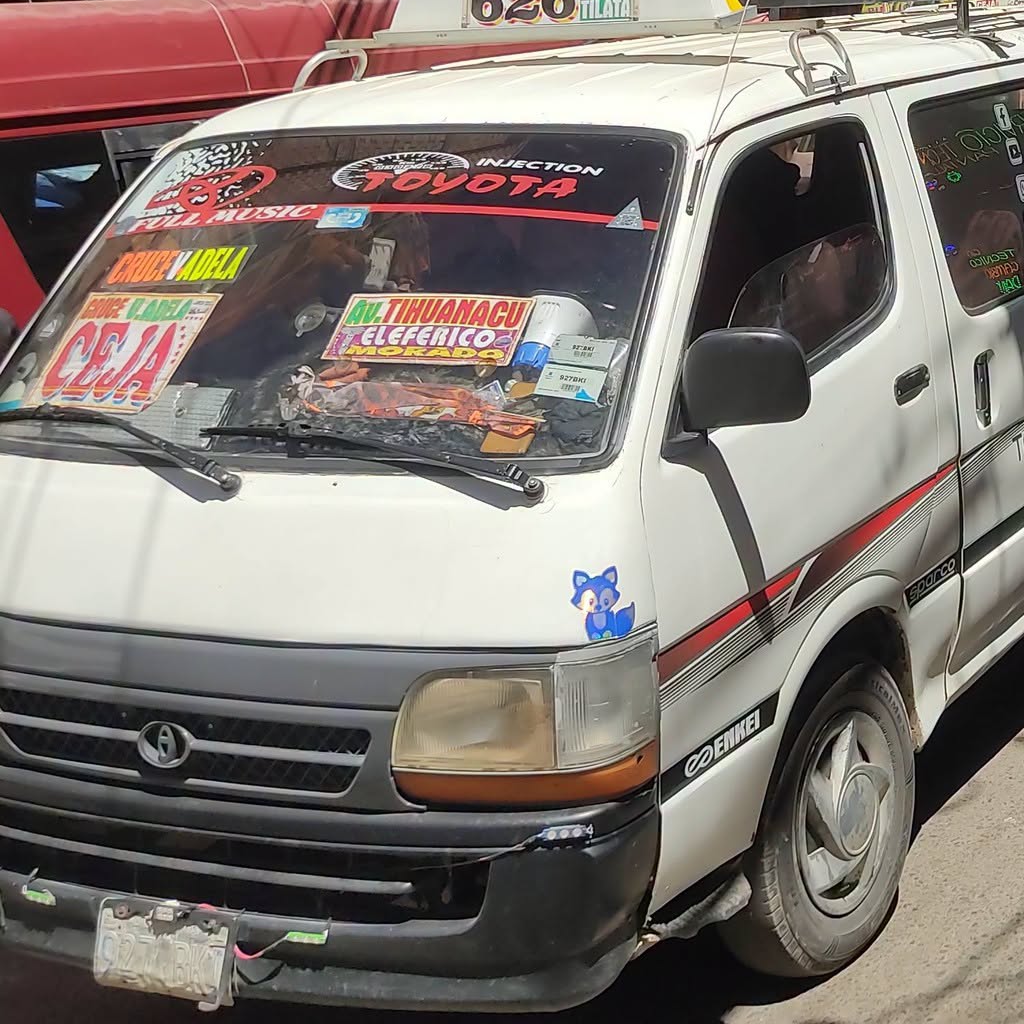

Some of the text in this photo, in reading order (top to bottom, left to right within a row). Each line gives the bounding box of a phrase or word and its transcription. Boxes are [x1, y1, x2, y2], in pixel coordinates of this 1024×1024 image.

[475, 157, 604, 176] INJECTION
[362, 171, 579, 199] TOYOTA
[133, 211, 200, 233] FULL
[205, 203, 318, 226] MUSIC
[107, 250, 181, 285] CRUCE
[175, 247, 249, 282] ADELA
[382, 298, 529, 328] TIHUANACU
[41, 321, 178, 405] CEJA
[345, 345, 505, 360] MORADO
[908, 558, 957, 605] sparco
[713, 708, 761, 760] ENKEI
